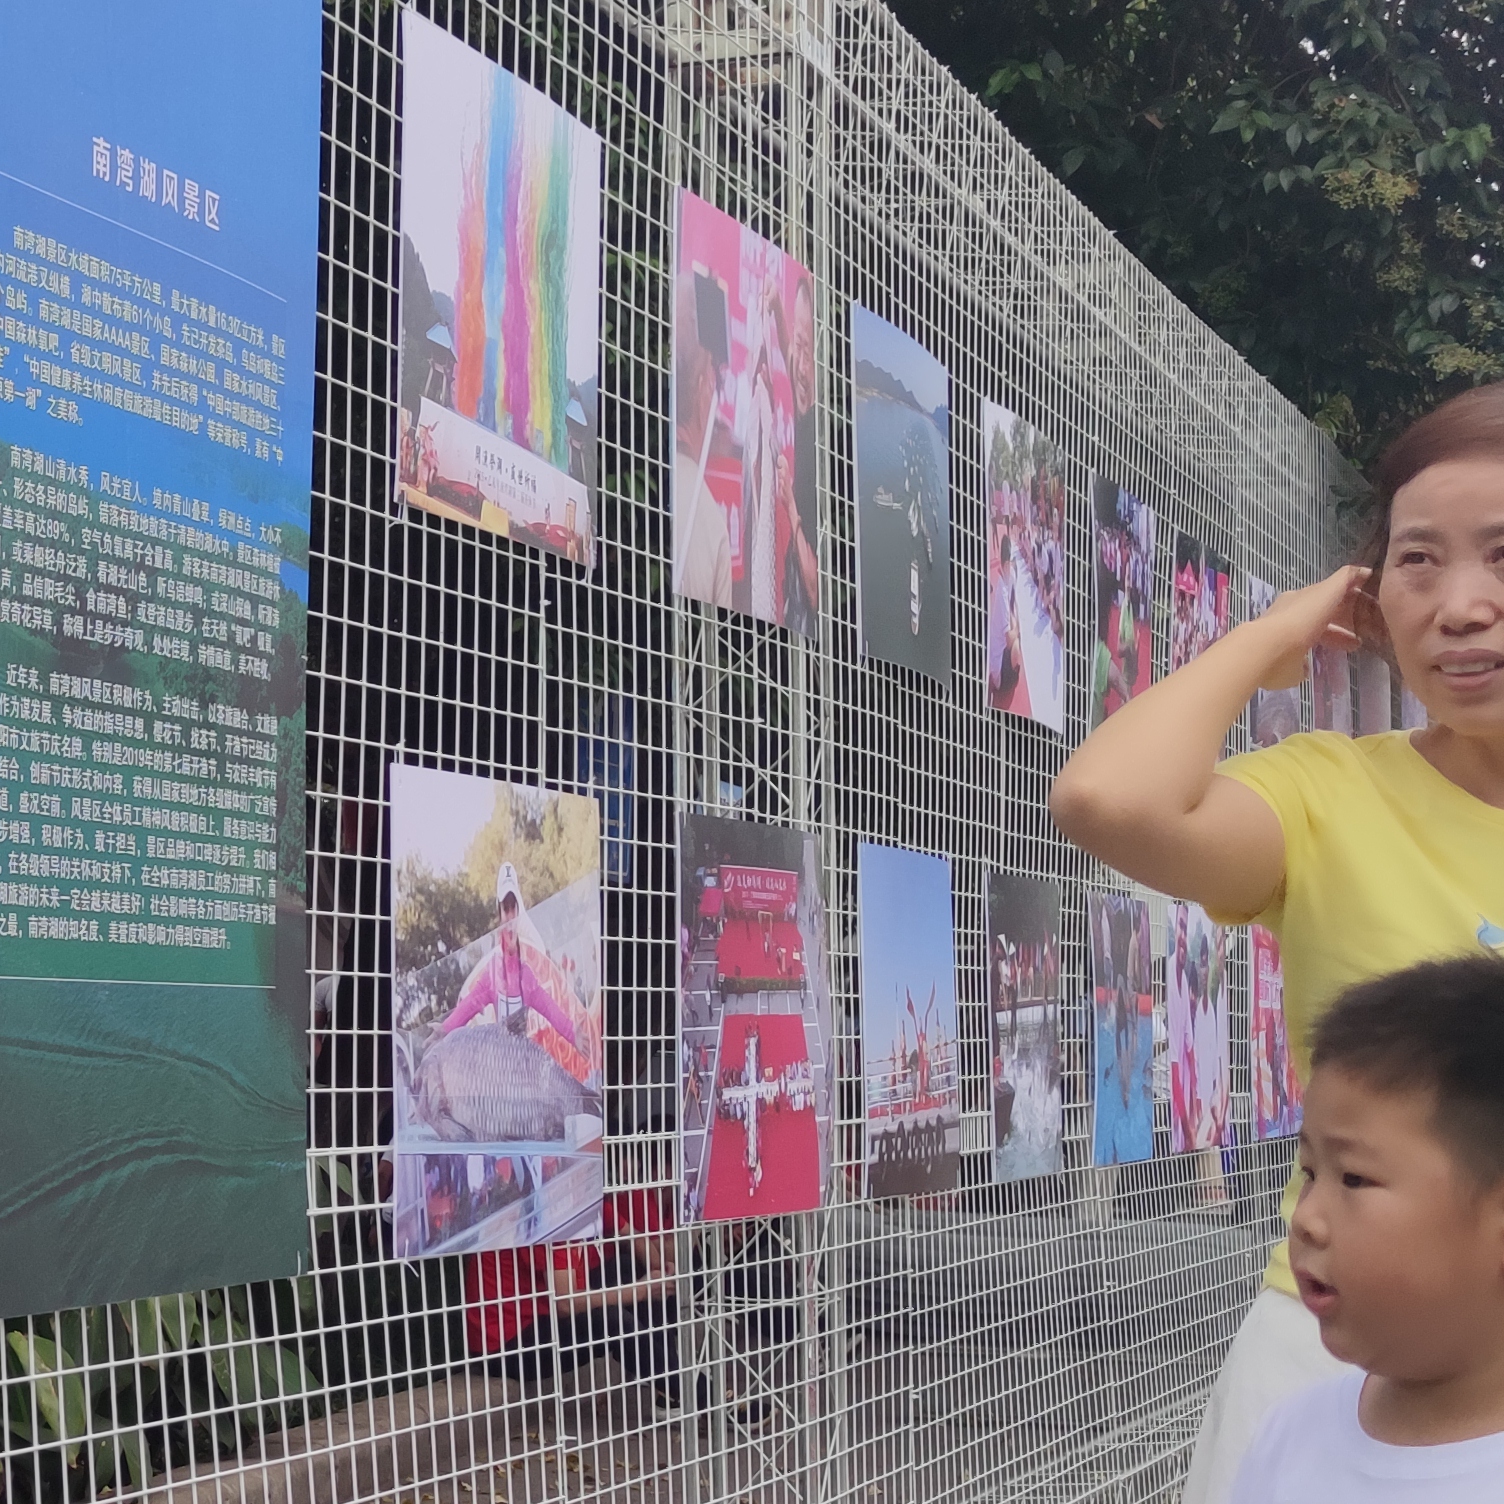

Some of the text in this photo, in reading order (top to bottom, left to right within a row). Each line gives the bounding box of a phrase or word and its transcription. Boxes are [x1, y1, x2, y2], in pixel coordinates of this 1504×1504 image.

[93, 137, 219, 230] 南湾湖风景区
